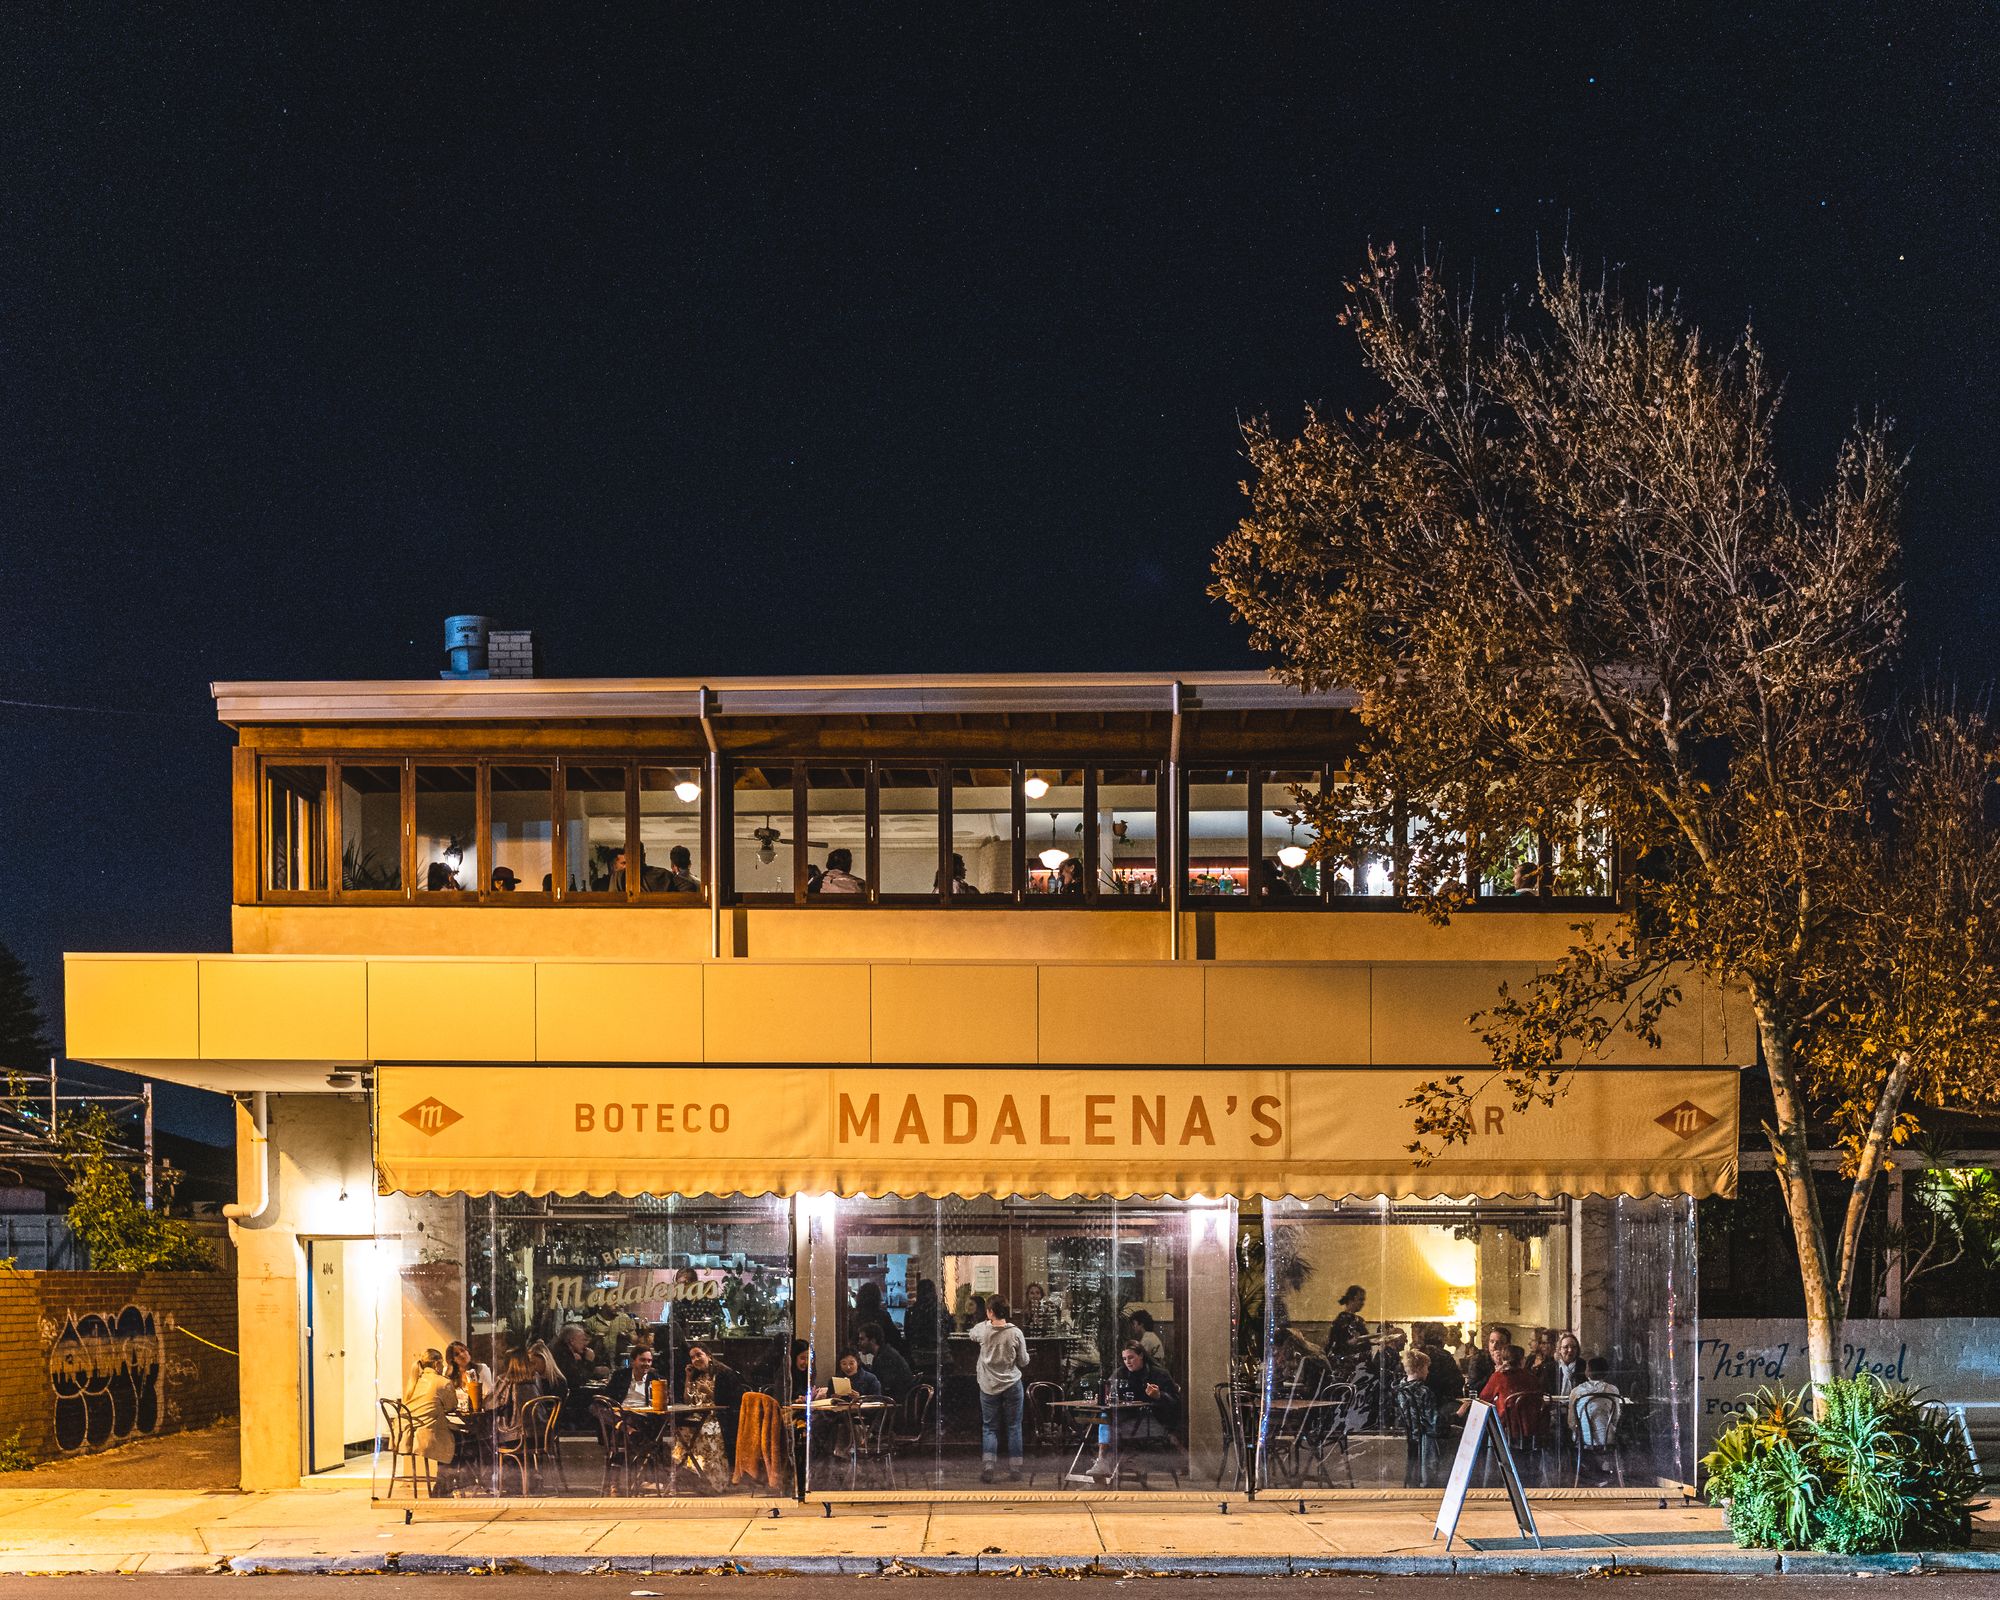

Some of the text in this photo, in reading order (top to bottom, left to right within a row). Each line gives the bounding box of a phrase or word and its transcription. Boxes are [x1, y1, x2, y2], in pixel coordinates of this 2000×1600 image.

[575, 1103, 730, 1133] BOTECO
[838, 1093, 1283, 1147] MADALENA'S
[601, 1246, 664, 1265] BOTECO
[1695, 1338, 1790, 1381] Third
